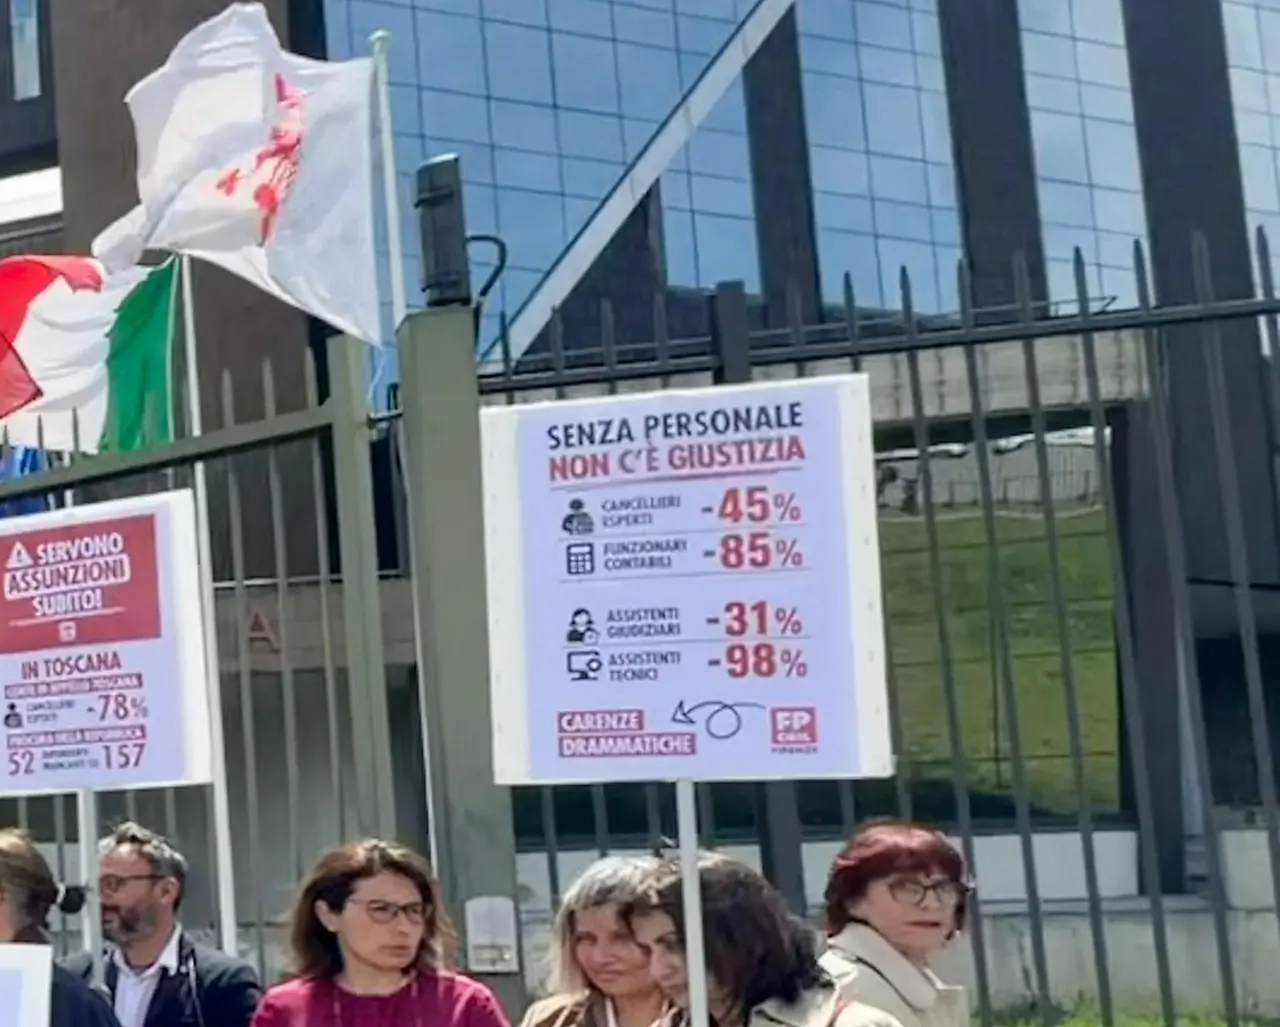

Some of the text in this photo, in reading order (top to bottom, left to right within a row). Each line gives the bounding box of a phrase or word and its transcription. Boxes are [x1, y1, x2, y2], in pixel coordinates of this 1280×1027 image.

[547, 402, 803, 449] SENZA PERSONALE
[549, 451, 610, 481] NON
[668, 435, 806, 470] GIUSTIZIA
[701, 485, 801, 523] -45%
[37, 531, 124, 565] SERVONO
[703, 532, 803, 569] -85%
[8, 558, 126, 595] ASSUNZIONI
[32, 588, 103, 617] SUBITO!
[607, 600, 803, 637] ASSISTENTI -31%
[607, 622, 680, 638] GIUDIZIARI
[22, 651, 122, 680] IN TOSCANA
[608, 643, 808, 678] ASSISTENTI -98%
[609, 668, 658, 681] TECNICI
[560, 711, 811, 732] CARENZE FP
[102, 743, 146, 769] 157
[561, 735, 692, 757] DRAMMATICHE
[9, 750, 34, 776] 52
